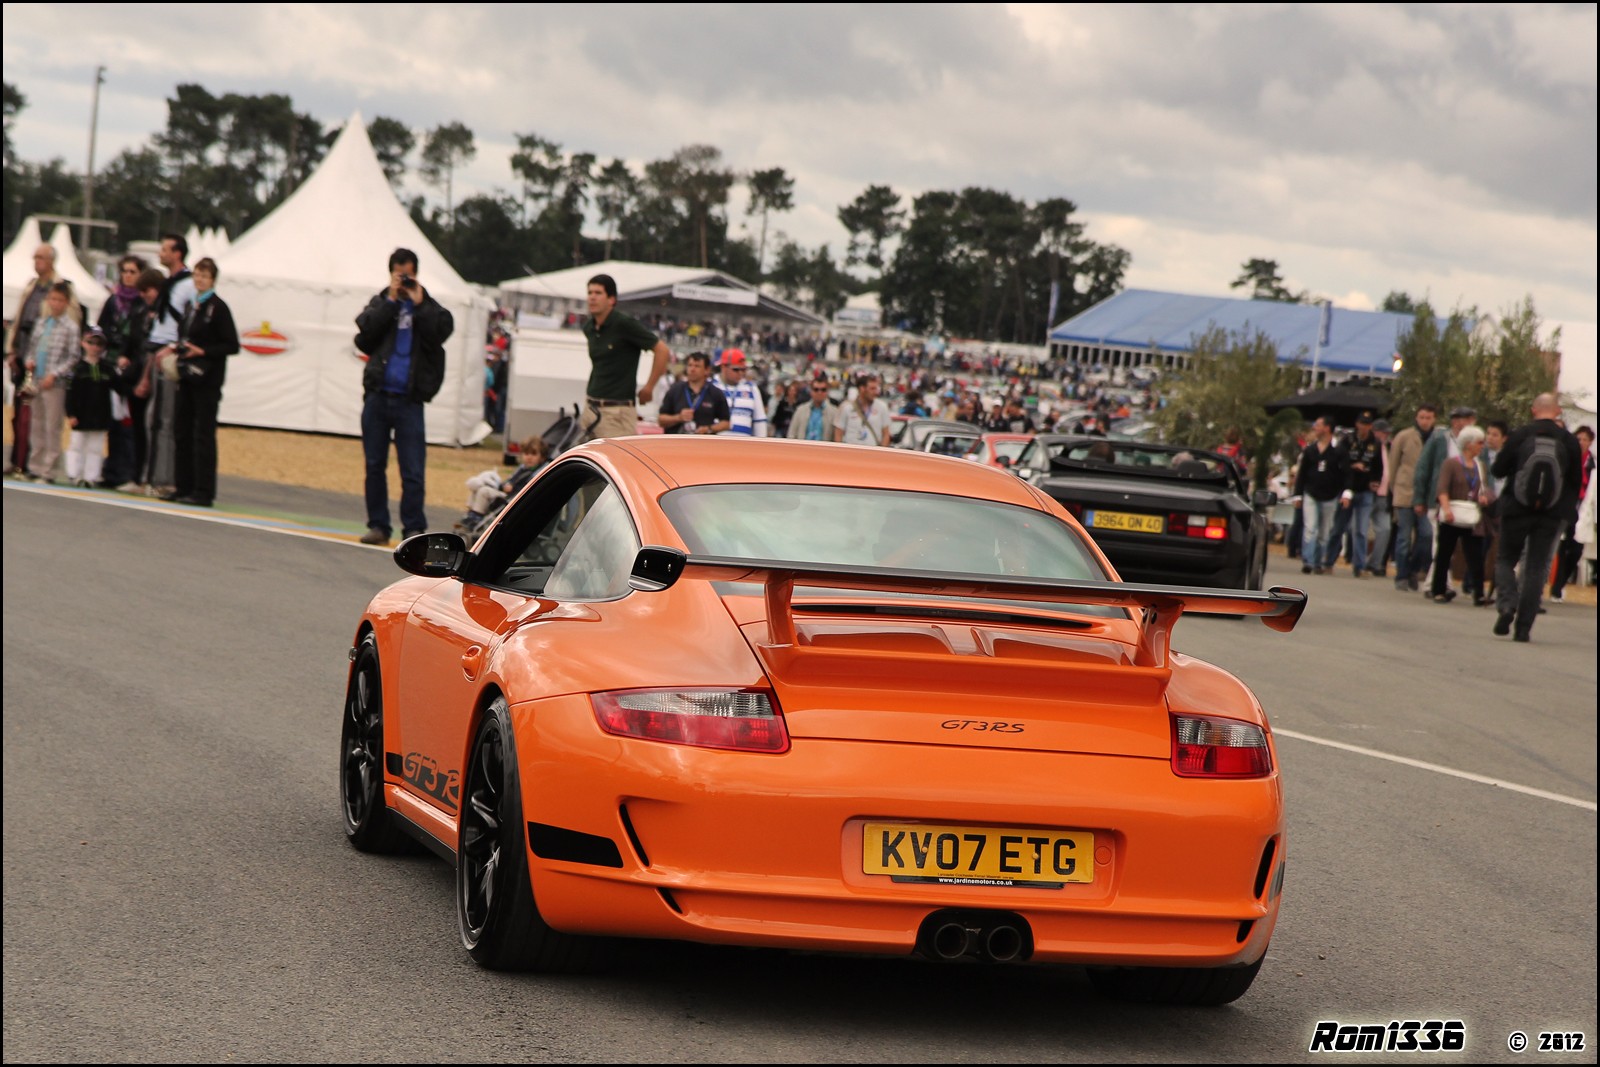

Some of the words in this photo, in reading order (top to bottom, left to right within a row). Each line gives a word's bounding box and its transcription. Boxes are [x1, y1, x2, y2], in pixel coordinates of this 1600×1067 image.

[1146, 518, 1161, 531] 40
[881, 830, 986, 872] KV07
[999, 835, 1076, 876] ETG
[938, 877, 1013, 885] www.jardinemotors.co.uk
